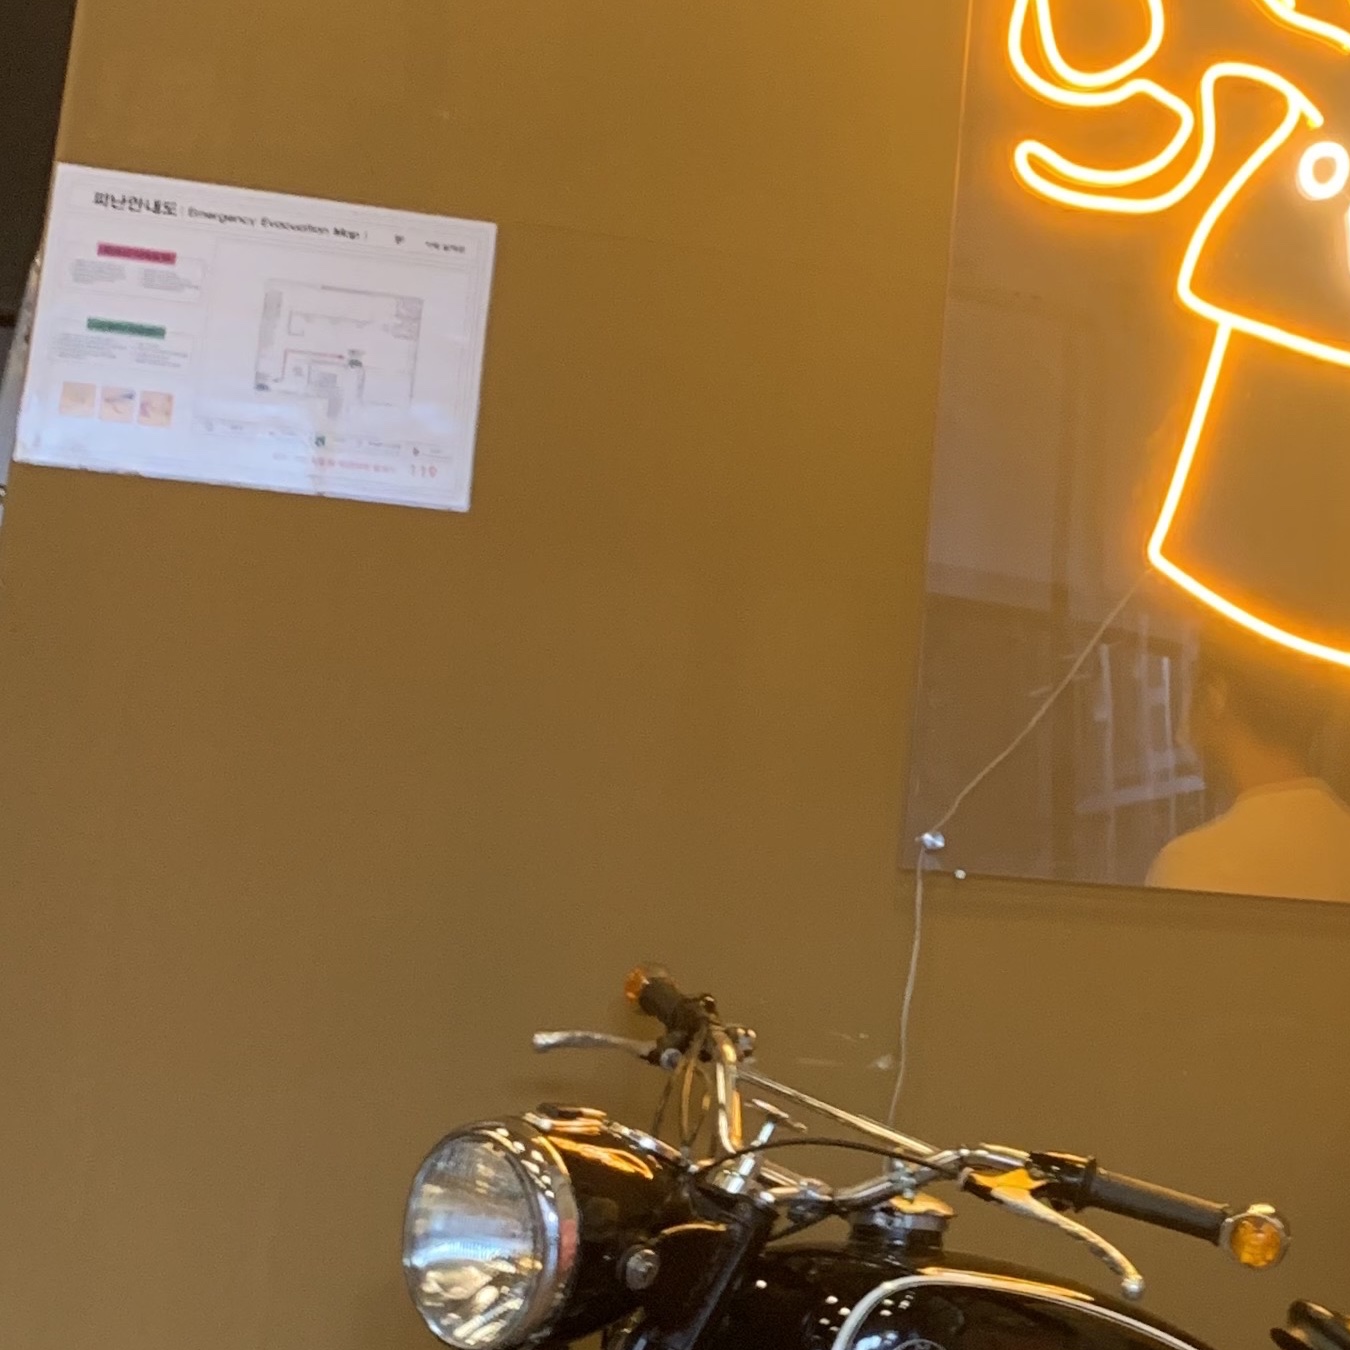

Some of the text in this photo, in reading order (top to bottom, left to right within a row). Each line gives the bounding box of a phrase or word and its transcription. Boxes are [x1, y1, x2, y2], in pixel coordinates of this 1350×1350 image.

[94, 191, 178, 217] 피난안내도
[188, 206, 255, 226] Emergency
[260, 216, 330, 234] Evacuation
